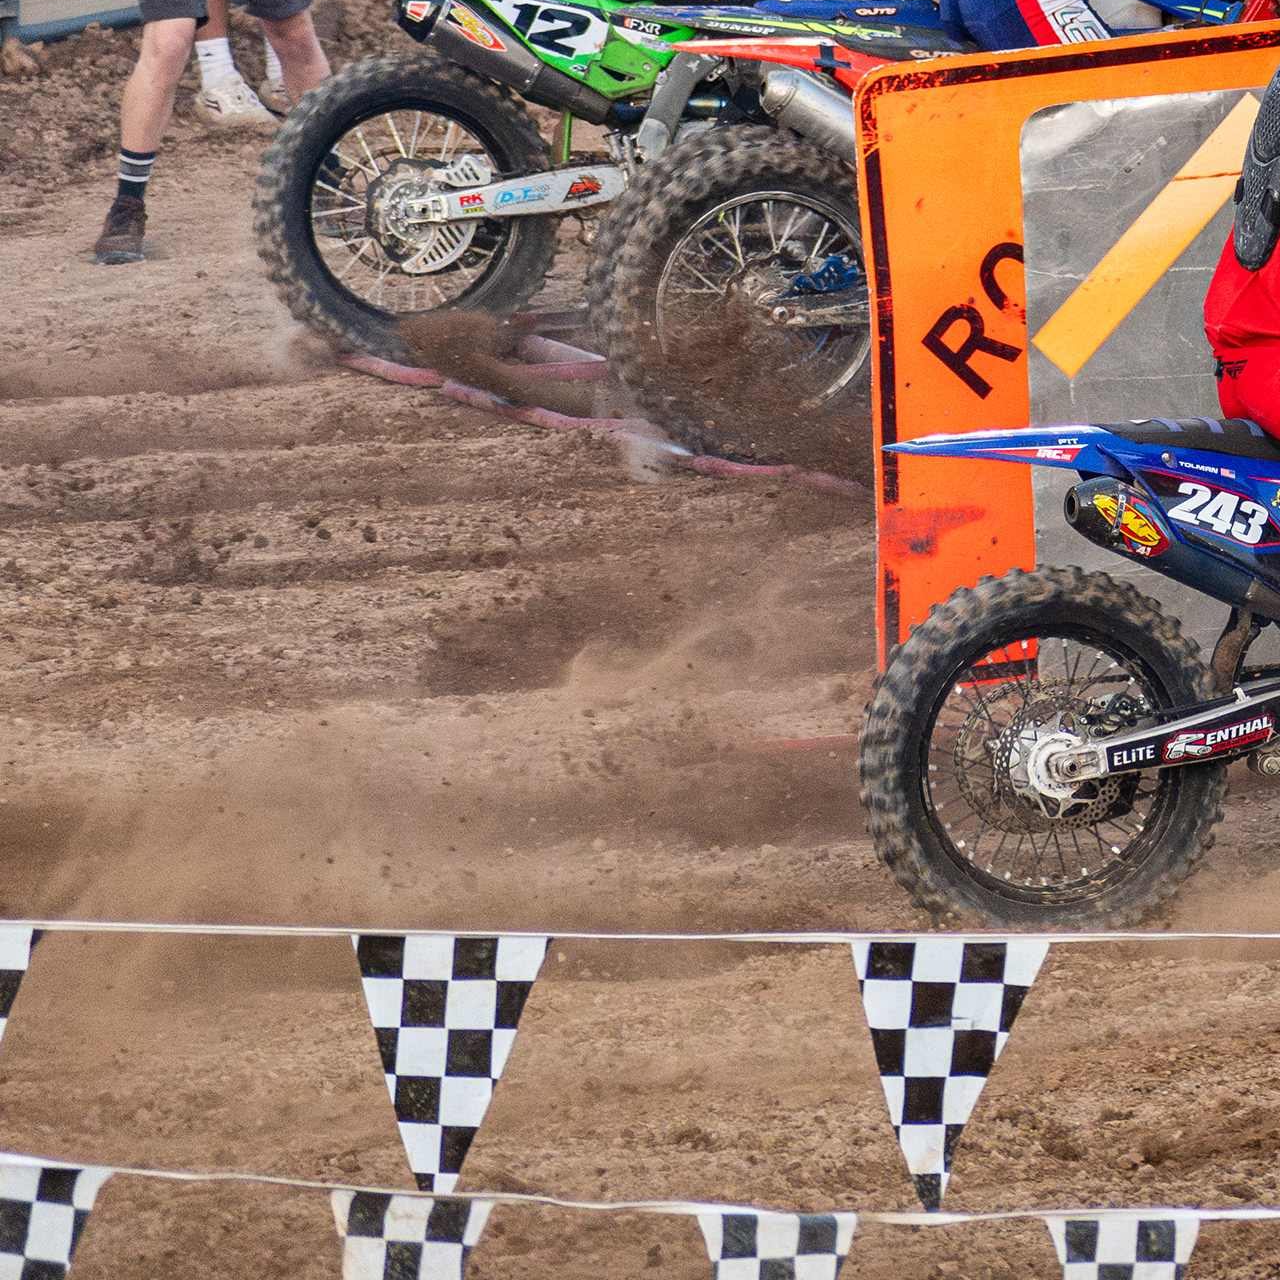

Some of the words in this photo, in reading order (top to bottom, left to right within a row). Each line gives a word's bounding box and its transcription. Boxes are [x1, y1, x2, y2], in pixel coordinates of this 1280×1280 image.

[855, 6, 898, 16] GUTS
[629, 19, 660, 36] FXR
[459, 193, 484, 206] RK
[1035, 448, 1062, 460] IRC
[1178, 461, 1219, 474] TOLMAN
[1168, 481, 1269, 545] 243
